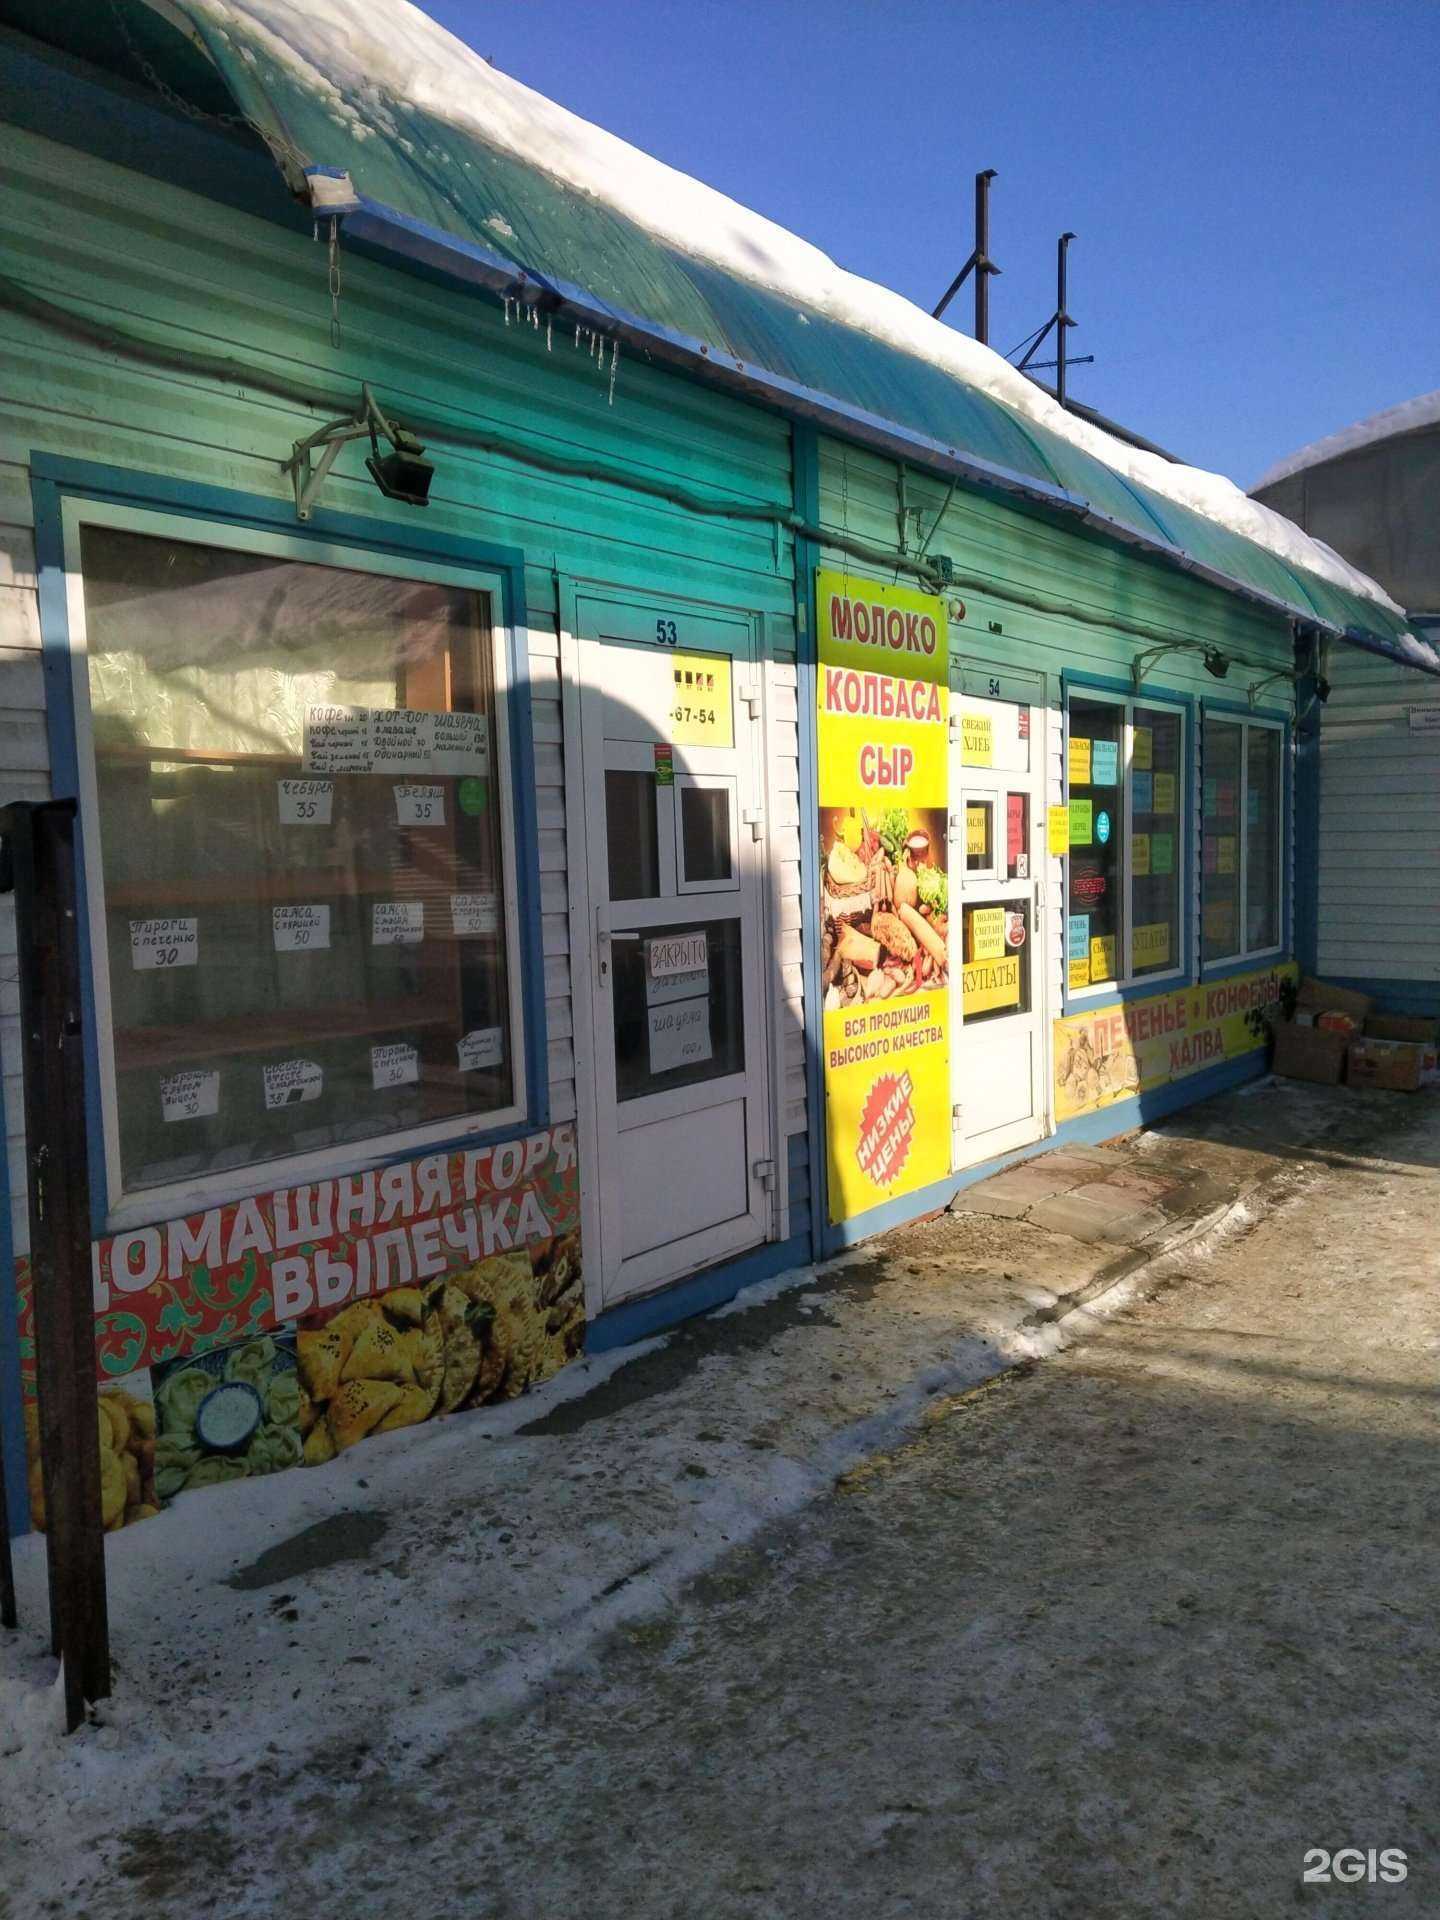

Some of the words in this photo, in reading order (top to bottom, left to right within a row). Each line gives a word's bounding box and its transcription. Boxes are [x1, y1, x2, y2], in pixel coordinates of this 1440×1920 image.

[656, 620, 678, 644] 53
[830, 596, 936, 655] МОЛОКО
[826, 668, 941, 721] КОЛБАСА
[989, 679, 1000, 696] 54
[962, 718, 991, 731] СВЕЖИЙ
[963, 735, 991, 752] ХЛЕБ
[860, 745, 913, 786] СЫР
[296, 801, 317, 818] 35
[415, 803, 432, 819] 35
[966, 840, 984, 853] ЫРЫ
[294, 930, 310, 945] 50
[155, 948, 178, 965] 30
[652, 939, 706, 969] ЗАКРЫТО
[962, 963, 1017, 994] КУПАТЫ
[844, 1019, 866, 1037] ВСЯ
[869, 1004, 930, 1032] ПРОДУКЦИЯ
[1094, 998, 1187, 1057] ПЕЧЕНЬЕ
[830, 1037, 890, 1068] ВЫСОКОГО
[892, 1026, 943, 1052] КАЧЕСТВА
[1168, 1027, 1224, 1070] ХАЛВА
[184, 1102, 200, 1115] 30
[857, 1070, 914, 1166] НИЗКИЕ
[464, 1122, 577, 1200] ГОРЯ
[871, 1109, 915, 1182] ЦЕНЫ
[272, 1191, 551, 1321] ВЫПЕЧКА
